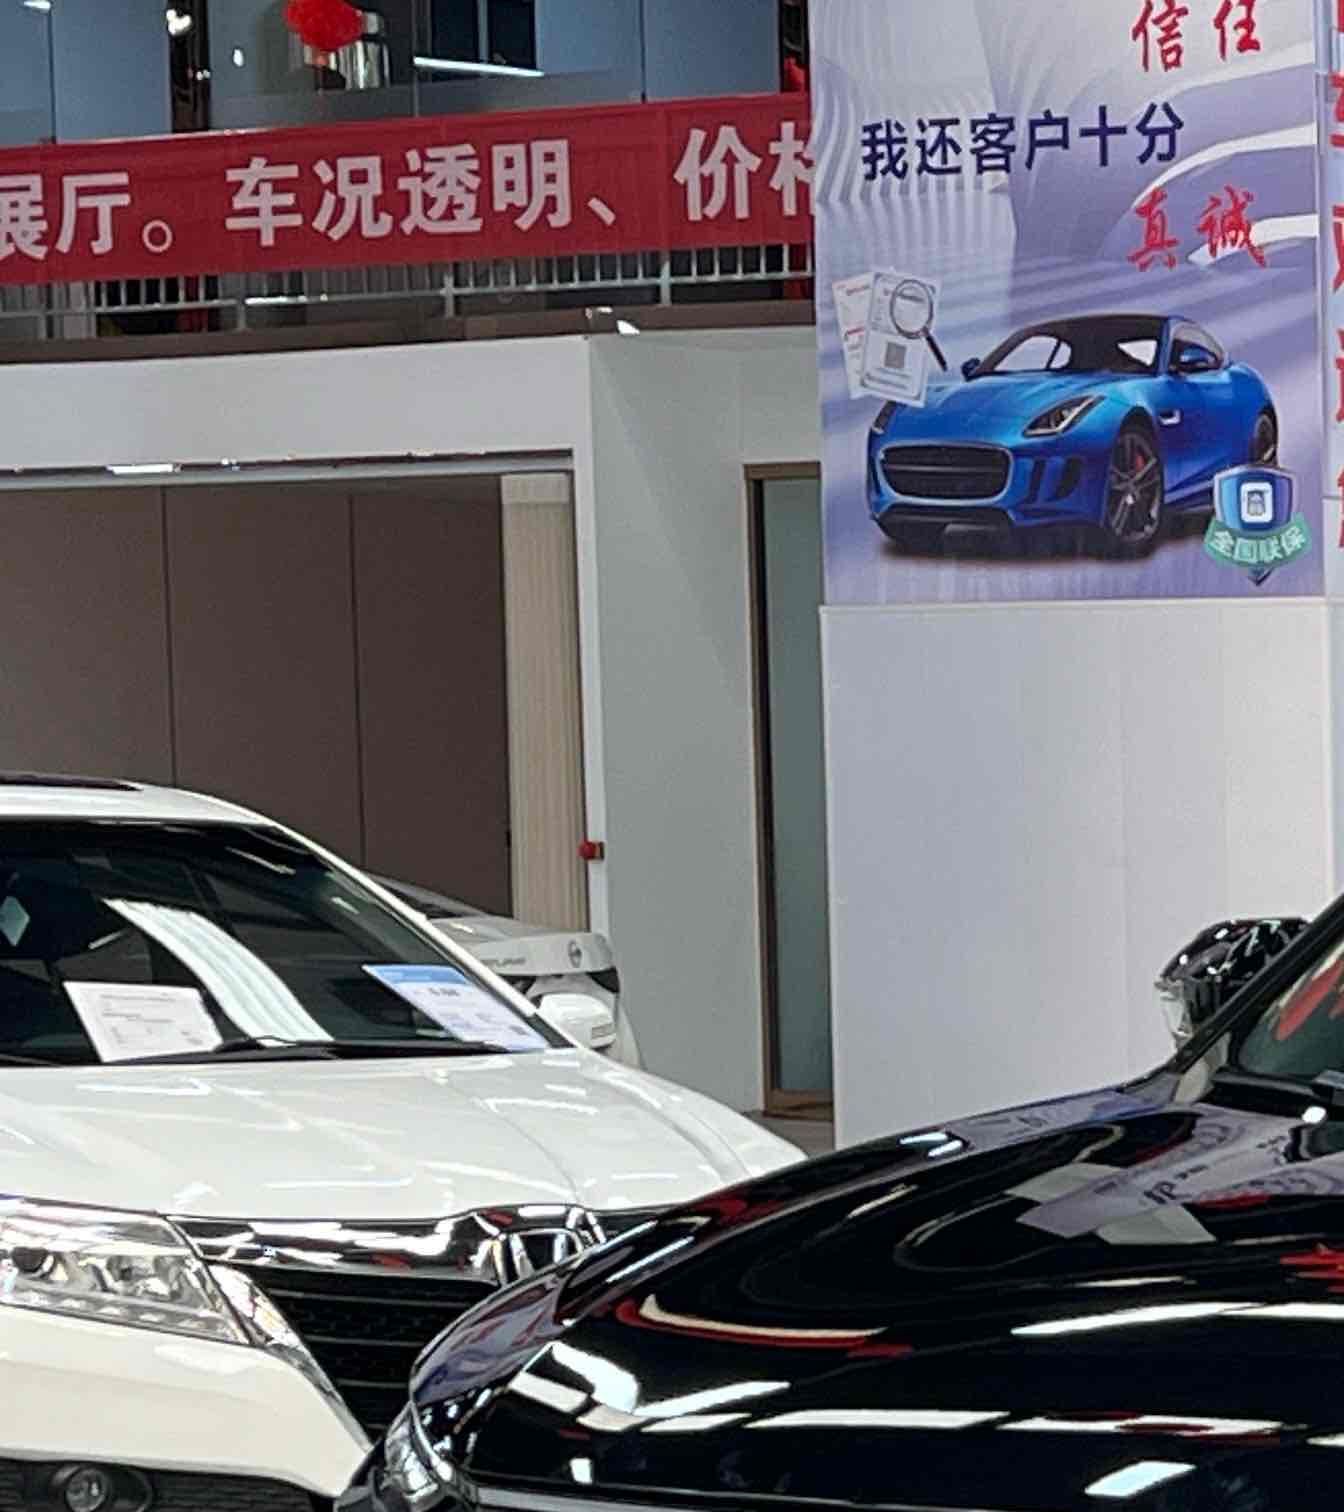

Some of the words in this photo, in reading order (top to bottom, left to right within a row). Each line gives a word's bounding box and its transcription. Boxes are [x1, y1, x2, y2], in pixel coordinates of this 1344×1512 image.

[860, 102, 1185, 182] 我还客户十分
